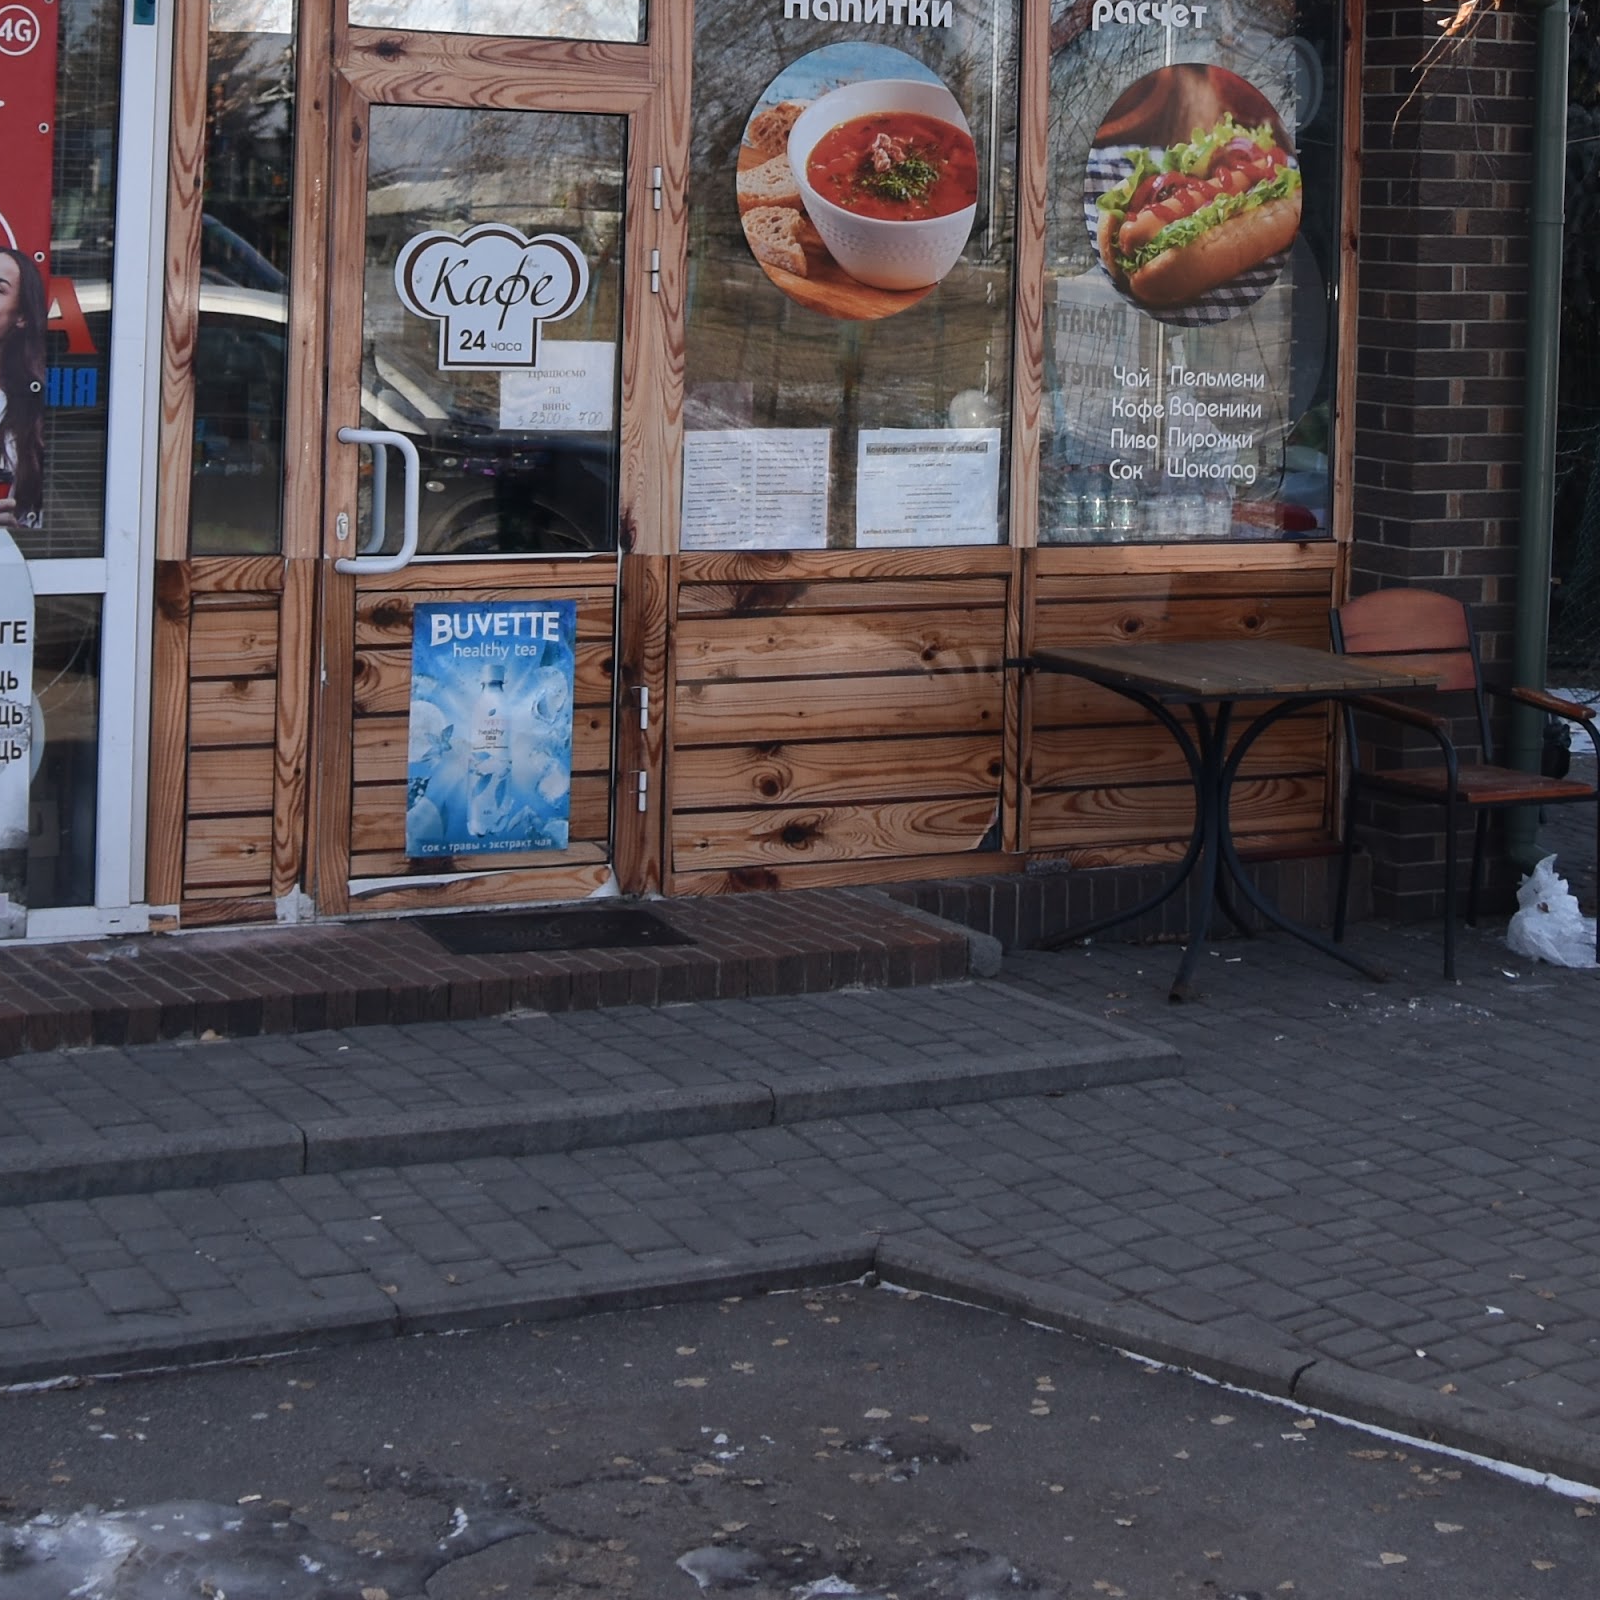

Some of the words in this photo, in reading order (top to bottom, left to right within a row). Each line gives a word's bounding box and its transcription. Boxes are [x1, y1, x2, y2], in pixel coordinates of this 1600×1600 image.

[430, 253, 556, 332] Кафе
[459, 328, 487, 351] 24
[490, 340, 522, 352] часа
[1113, 365, 1150, 388] Чай
[1171, 365, 1266, 389] Пельмени
[1111, 398, 1165, 424] Кофе
[1169, 396, 1262, 424] Вареники
[1110, 427, 1159, 450] Пиво
[1168, 426, 1253, 453] Пирожки
[1109, 458, 1144, 480] Сок
[1167, 457, 1257, 485] Шоколад
[430, 611, 560, 647] BUVETTE
[452, 642, 510, 661] healthy
[514, 643, 538, 657] tea
[421, 843, 441, 853] сок
[448, 841, 480, 853] травы
[489, 839, 532, 851] экстракт
